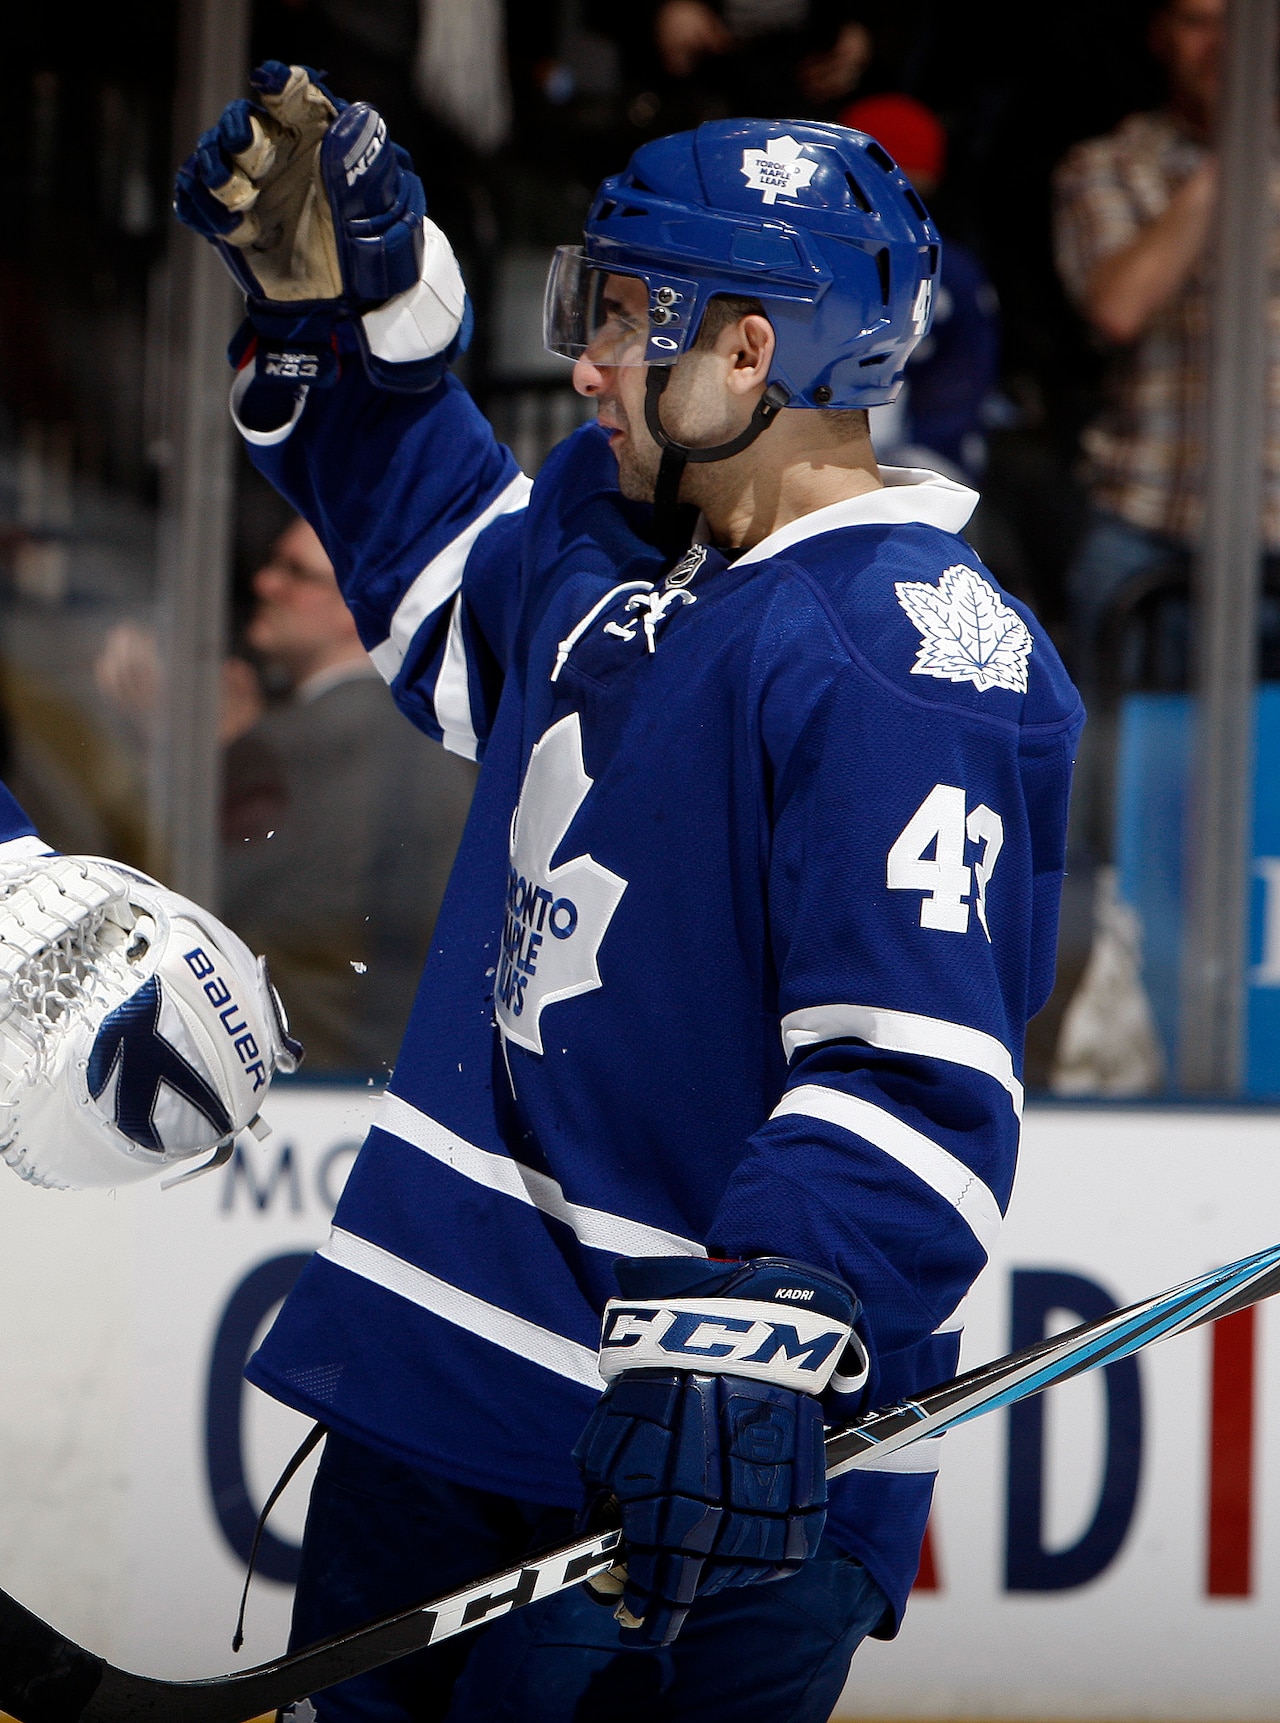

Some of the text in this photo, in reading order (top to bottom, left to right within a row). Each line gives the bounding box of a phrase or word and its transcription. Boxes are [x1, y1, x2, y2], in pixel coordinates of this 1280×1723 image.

[346, 117, 388, 187] CCM
[760, 167, 792, 181] MAPLE
[760, 176, 788, 188] LEAFS
[886, 783, 1005, 943] 43
[774, 1287, 815, 1301] KADRI
[601, 1308, 845, 1373] CCM
